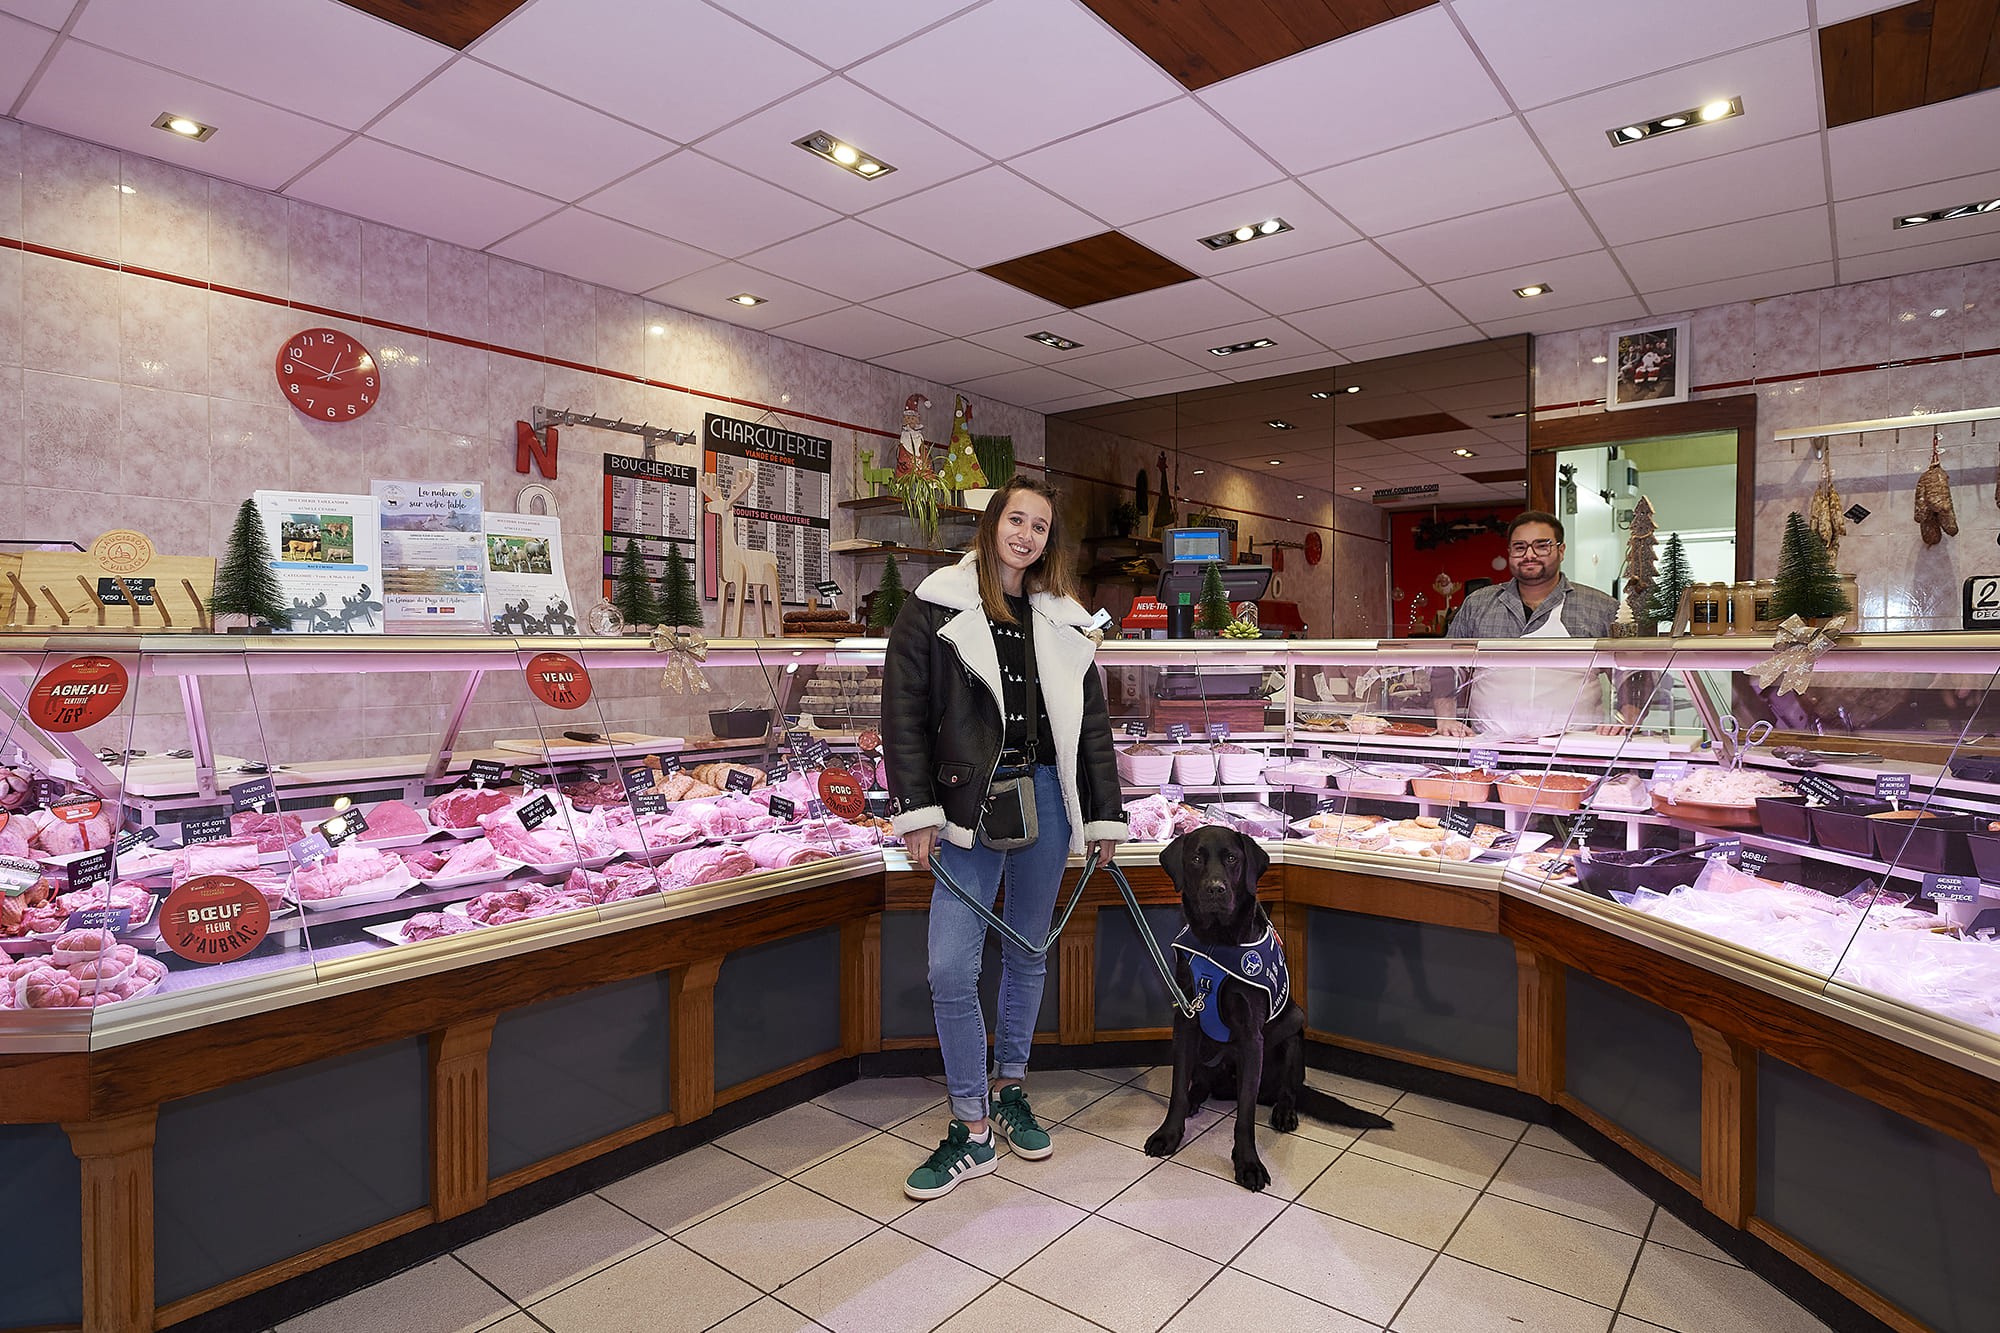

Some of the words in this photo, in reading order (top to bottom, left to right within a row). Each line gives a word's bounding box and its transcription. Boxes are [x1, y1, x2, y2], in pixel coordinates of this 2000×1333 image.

[303, 335, 313, 347] 11
[322, 333, 335, 345] 12
[289, 347, 303, 359] 10
[347, 344, 352, 353] 1
[284, 364, 294, 375] 9
[366, 377, 375, 387] 3
[290, 384, 300, 394] 8
[306, 399, 315, 409] 7
[361, 393, 369, 404] 4
[327, 408, 336, 417] 6
[348, 405, 356, 415] 5
[710, 418, 827, 460] CHARCUTERIE
[516, 420, 559, 480] N
[745, 449, 769, 461] VIANDE
[770, 454, 778, 463] DE
[780, 457, 796, 466] PORC
[611, 456, 690, 480] BOUCHERIE
[418, 487, 430, 498] La
[432, 488, 459, 498] nature
[1374, 484, 1440, 496] www.cournon.com
[426, 500, 446, 509] votre
[447, 500, 467, 510] table
[733, 508, 760, 519] RODUITS
[761, 512, 769, 520] DE
[770, 513, 811, 526] CHARCUTERIE
[102, 535, 147, 552] SAUCISSON
[110, 559, 146, 572] VILLAGE
[1976, 581, 2000, 608] 2
[542, 673, 574, 683] VEAU
[51, 684, 110, 697] AGNEAU
[553, 691, 578, 703] LAIT
[53, 708, 83, 724] IGP
[830, 785, 852, 795] PORC
[1811, 781, 1841, 801] STRASBOURG
[344, 810, 359, 820] VEAU
[186, 822, 201, 830] PLAT
[211, 819, 227, 827] COTE
[348, 826, 357, 834] LE
[356, 822, 365, 830] KG
[202, 827, 221, 835] BOEUF
[1458, 827, 1471, 836] PART
[209, 835, 216, 843] LE
[218, 834, 228, 842] KG
[80, 856, 104, 868] COLLIER
[78, 863, 107, 876] D'AGNEAU
[74, 876, 93, 887] 16€90
[94, 873, 102, 881] LE
[1951, 893, 1973, 902] PIECE
[187, 903, 242, 924] BŒUF
[205, 921, 232, 935] FLEUR
[180, 925, 259, 955] D'AUBRAC
